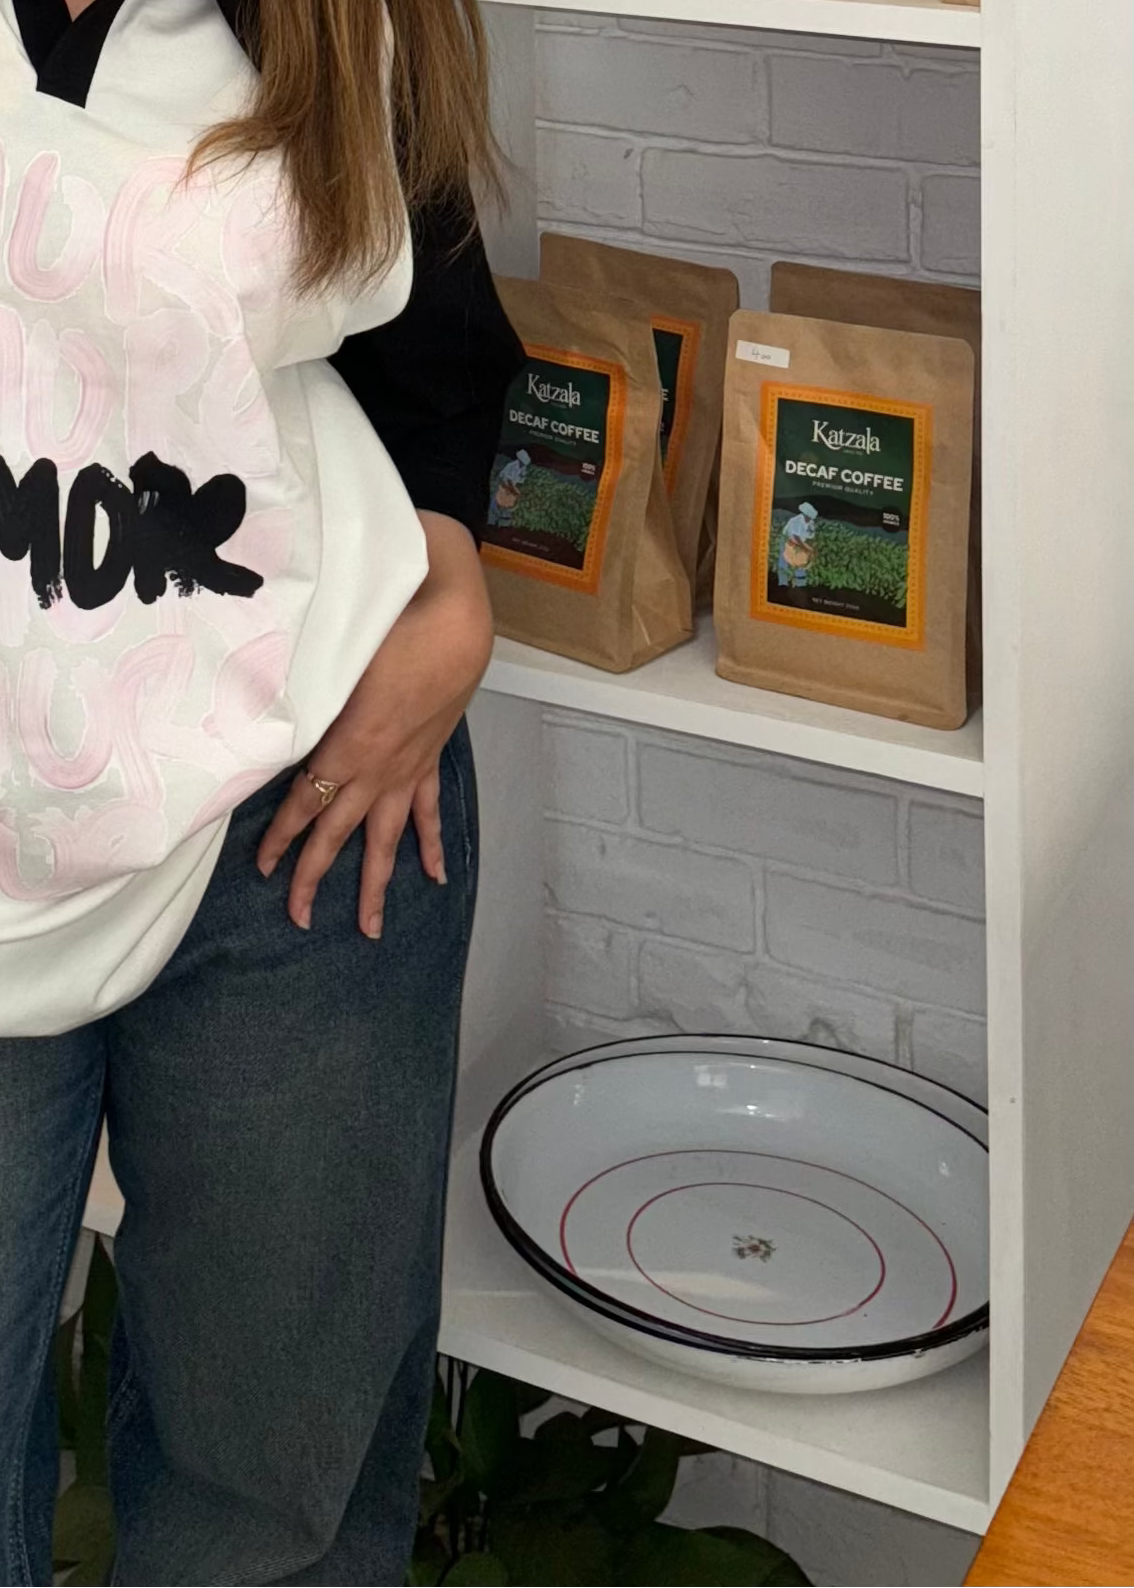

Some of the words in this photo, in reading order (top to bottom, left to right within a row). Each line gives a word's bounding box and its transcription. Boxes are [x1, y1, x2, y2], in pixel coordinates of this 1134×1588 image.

[527, 373, 581, 408] Katzala
[509, 409, 549, 430] DECAF
[551, 421, 600, 444] COFFEE
[811, 420, 881, 455] Katzala
[785, 460, 838, 480] DECAF
[841, 469, 904, 492] COFFEE
